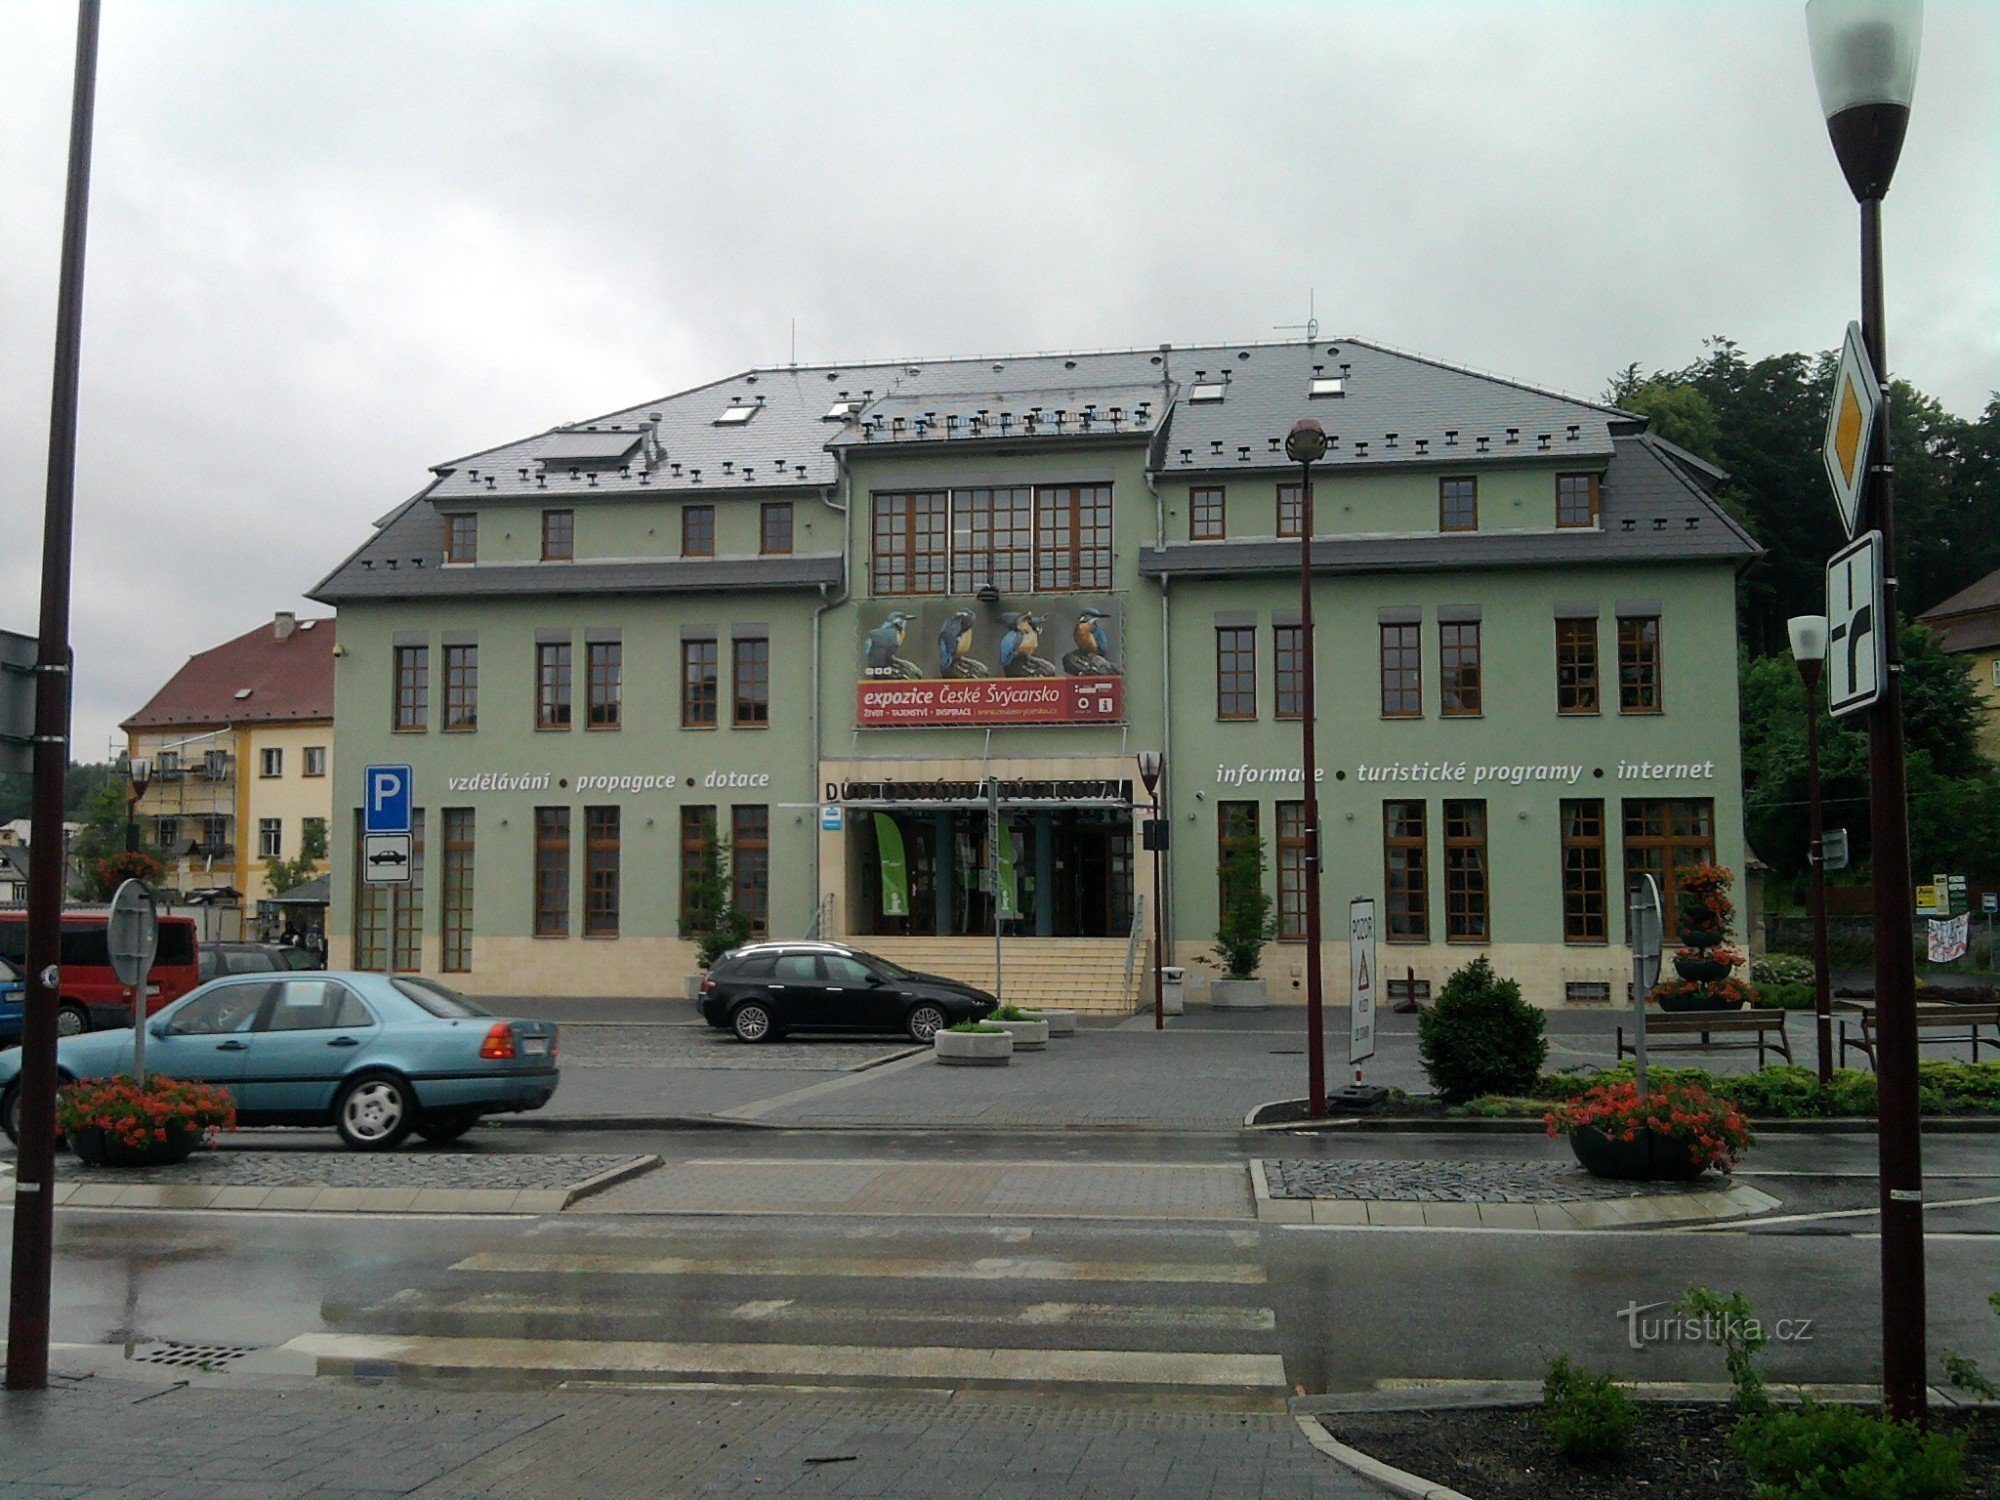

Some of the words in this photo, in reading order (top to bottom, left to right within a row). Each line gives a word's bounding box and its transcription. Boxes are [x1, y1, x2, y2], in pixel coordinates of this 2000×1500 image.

[864, 687, 934, 708] expozice
[939, 684, 981, 704] České
[986, 683, 1060, 707] Švýcarsko
[449, 772, 551, 791] vzdělávání
[576, 772, 676, 793] propagace
[704, 769, 770, 788] dotace
[1216, 763, 1324, 787] informae
[1357, 761, 1466, 782] turistické
[1473, 762, 1583, 785] programy
[1617, 760, 1714, 780] internet
[375, 773, 401, 812] P
